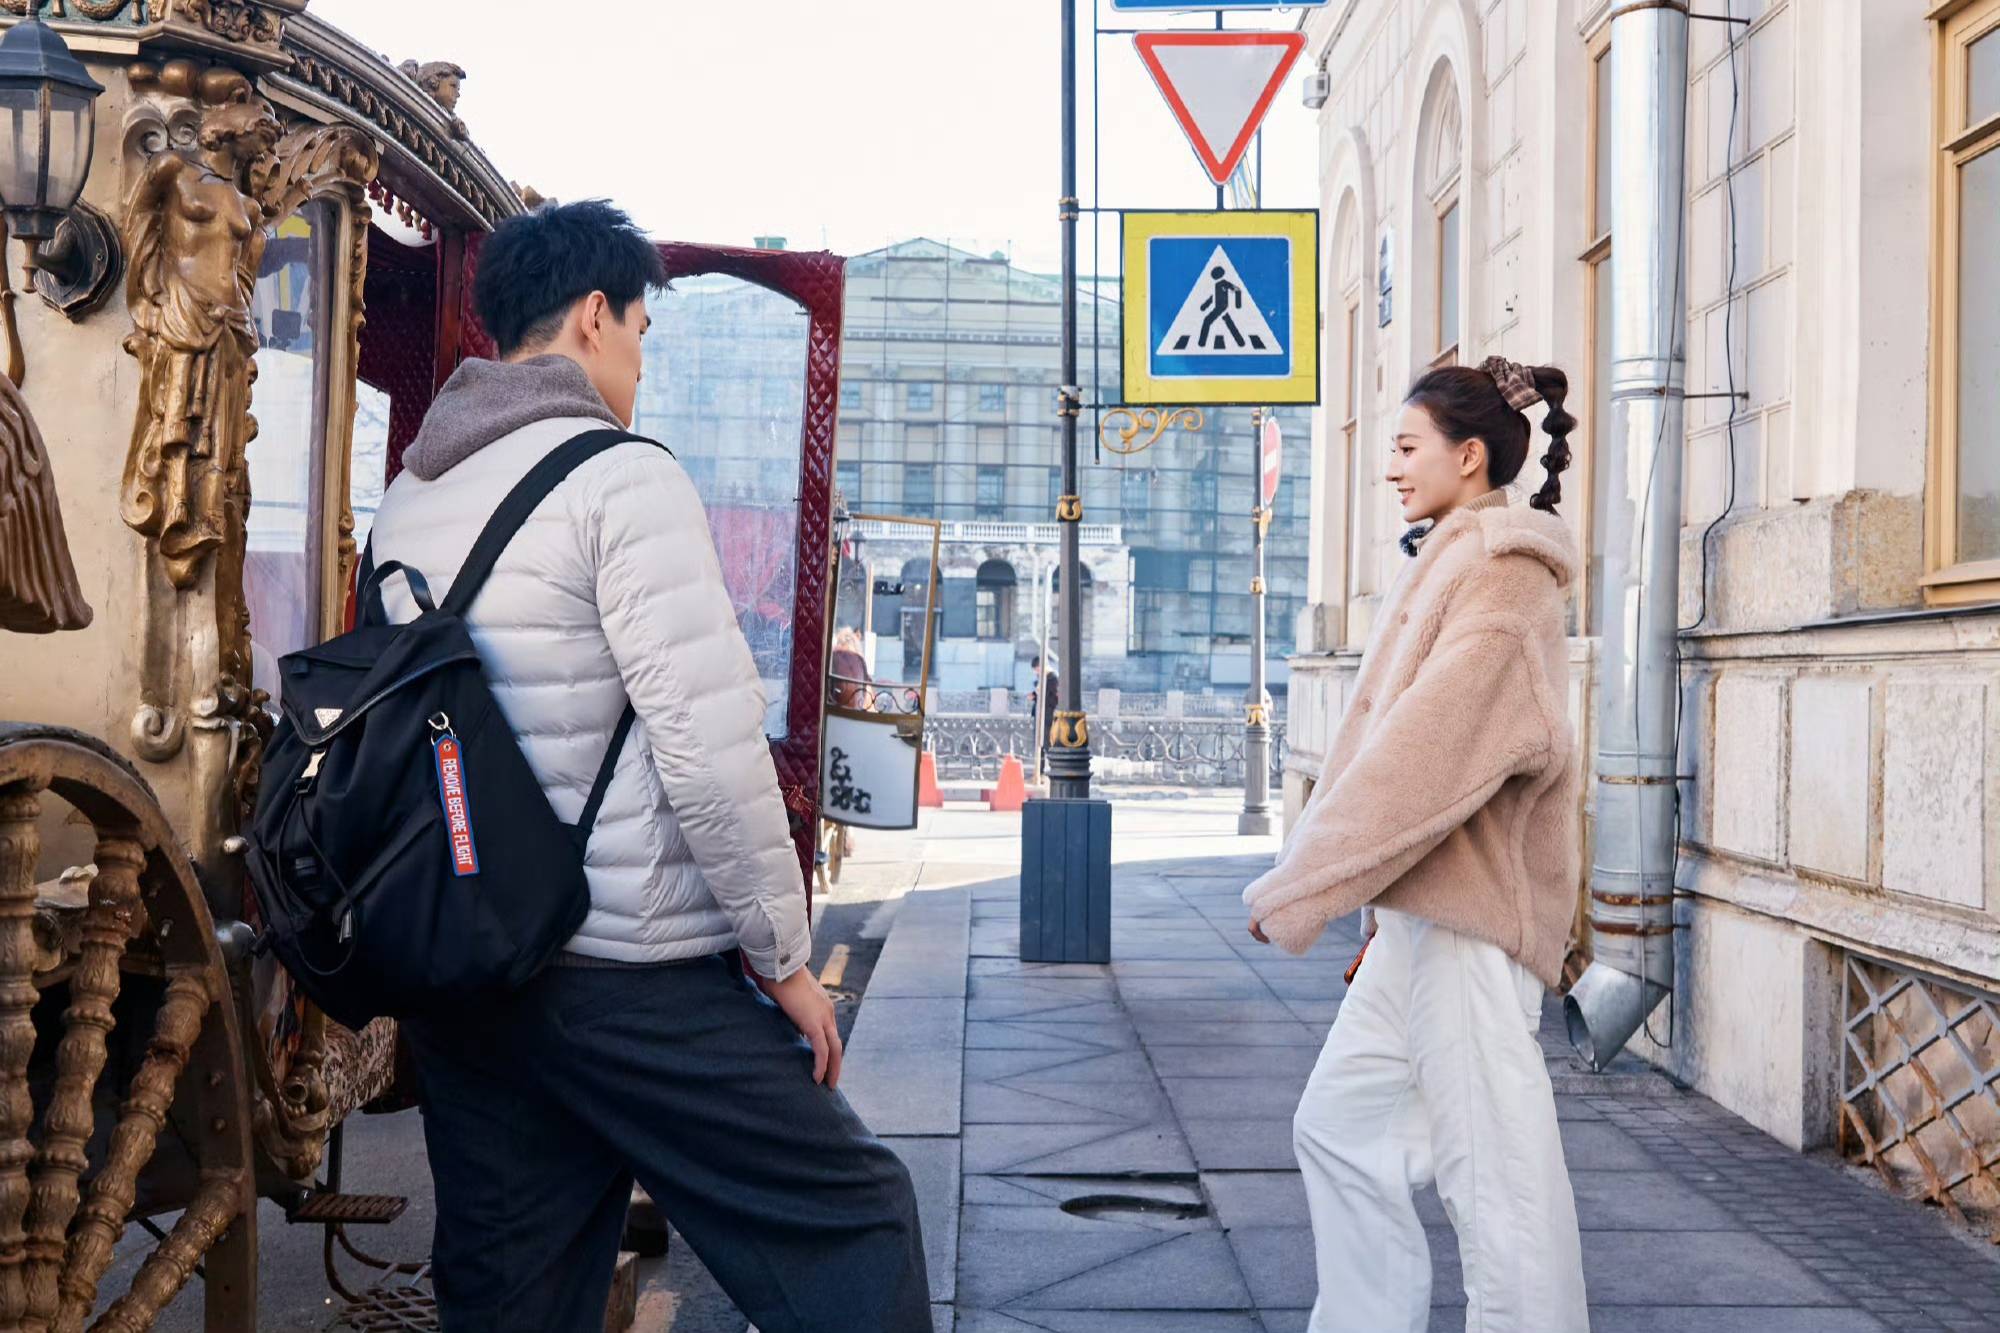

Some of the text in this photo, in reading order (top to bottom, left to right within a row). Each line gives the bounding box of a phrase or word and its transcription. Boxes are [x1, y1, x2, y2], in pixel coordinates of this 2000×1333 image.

[442, 759, 472, 865] REMOVE BEFORE FLIGHT
